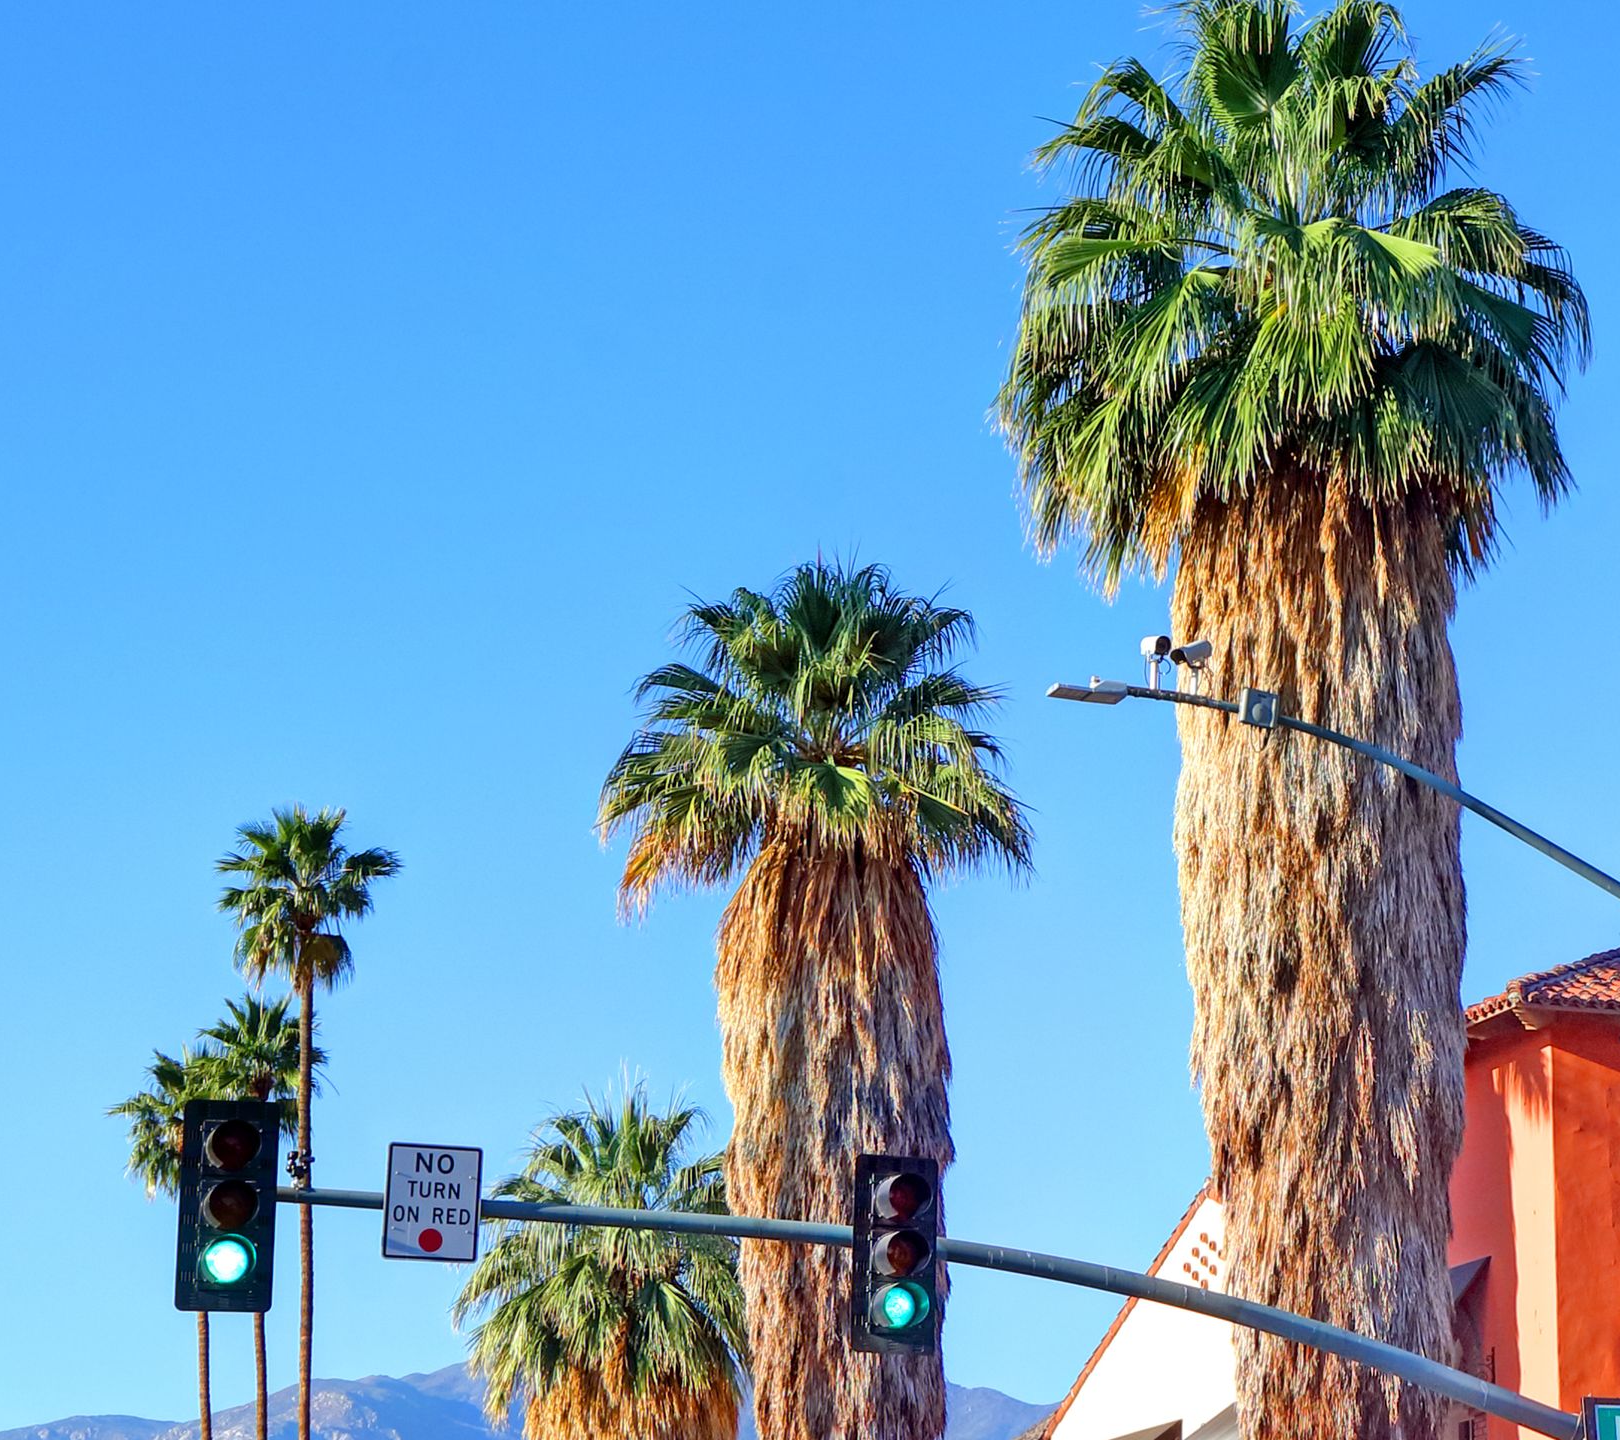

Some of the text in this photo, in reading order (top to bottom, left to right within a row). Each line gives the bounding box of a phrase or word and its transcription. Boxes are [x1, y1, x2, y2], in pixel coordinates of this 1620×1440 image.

[415, 1152, 455, 1174] NO
[407, 1180, 460, 1200] TURN
[393, 1205, 471, 1225] ON RED
